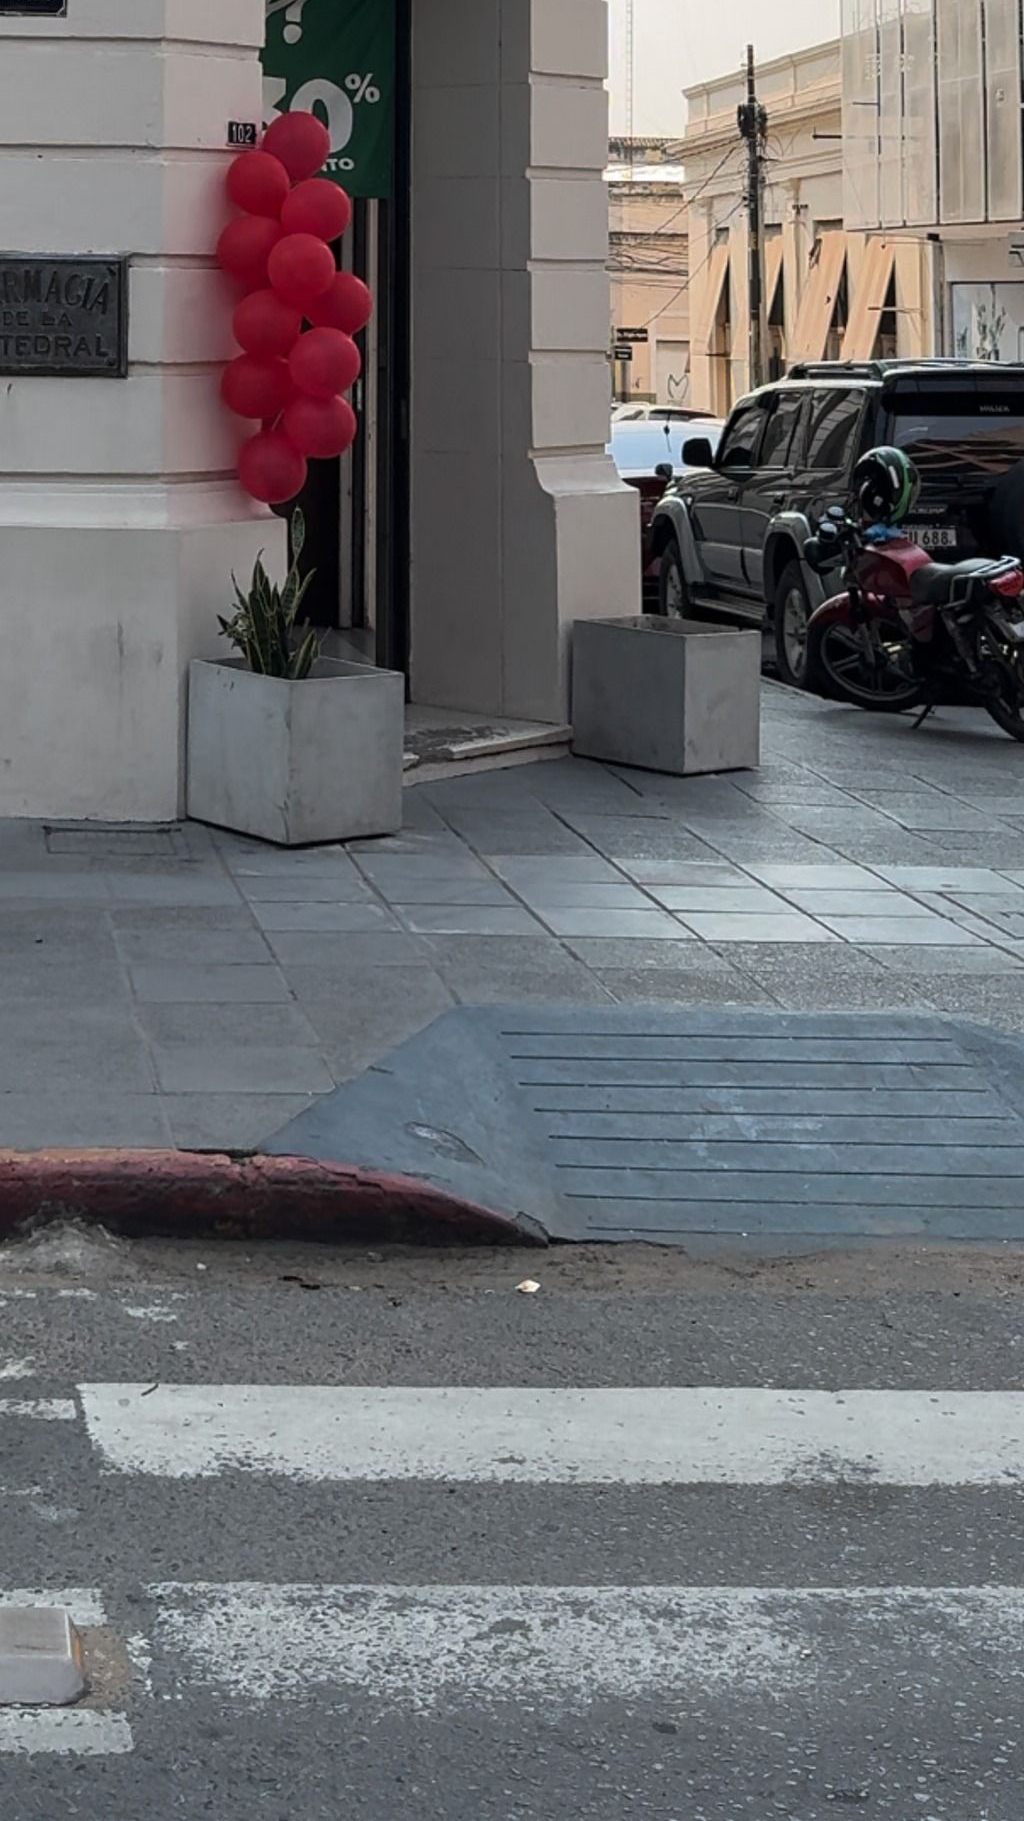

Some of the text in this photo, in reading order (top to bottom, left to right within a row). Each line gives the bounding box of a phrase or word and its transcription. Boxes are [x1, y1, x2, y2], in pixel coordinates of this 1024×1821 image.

[232, 124, 253, 143] 102
[2, 311, 74, 327] DE LA
[922, 530, 949, 546] 688
